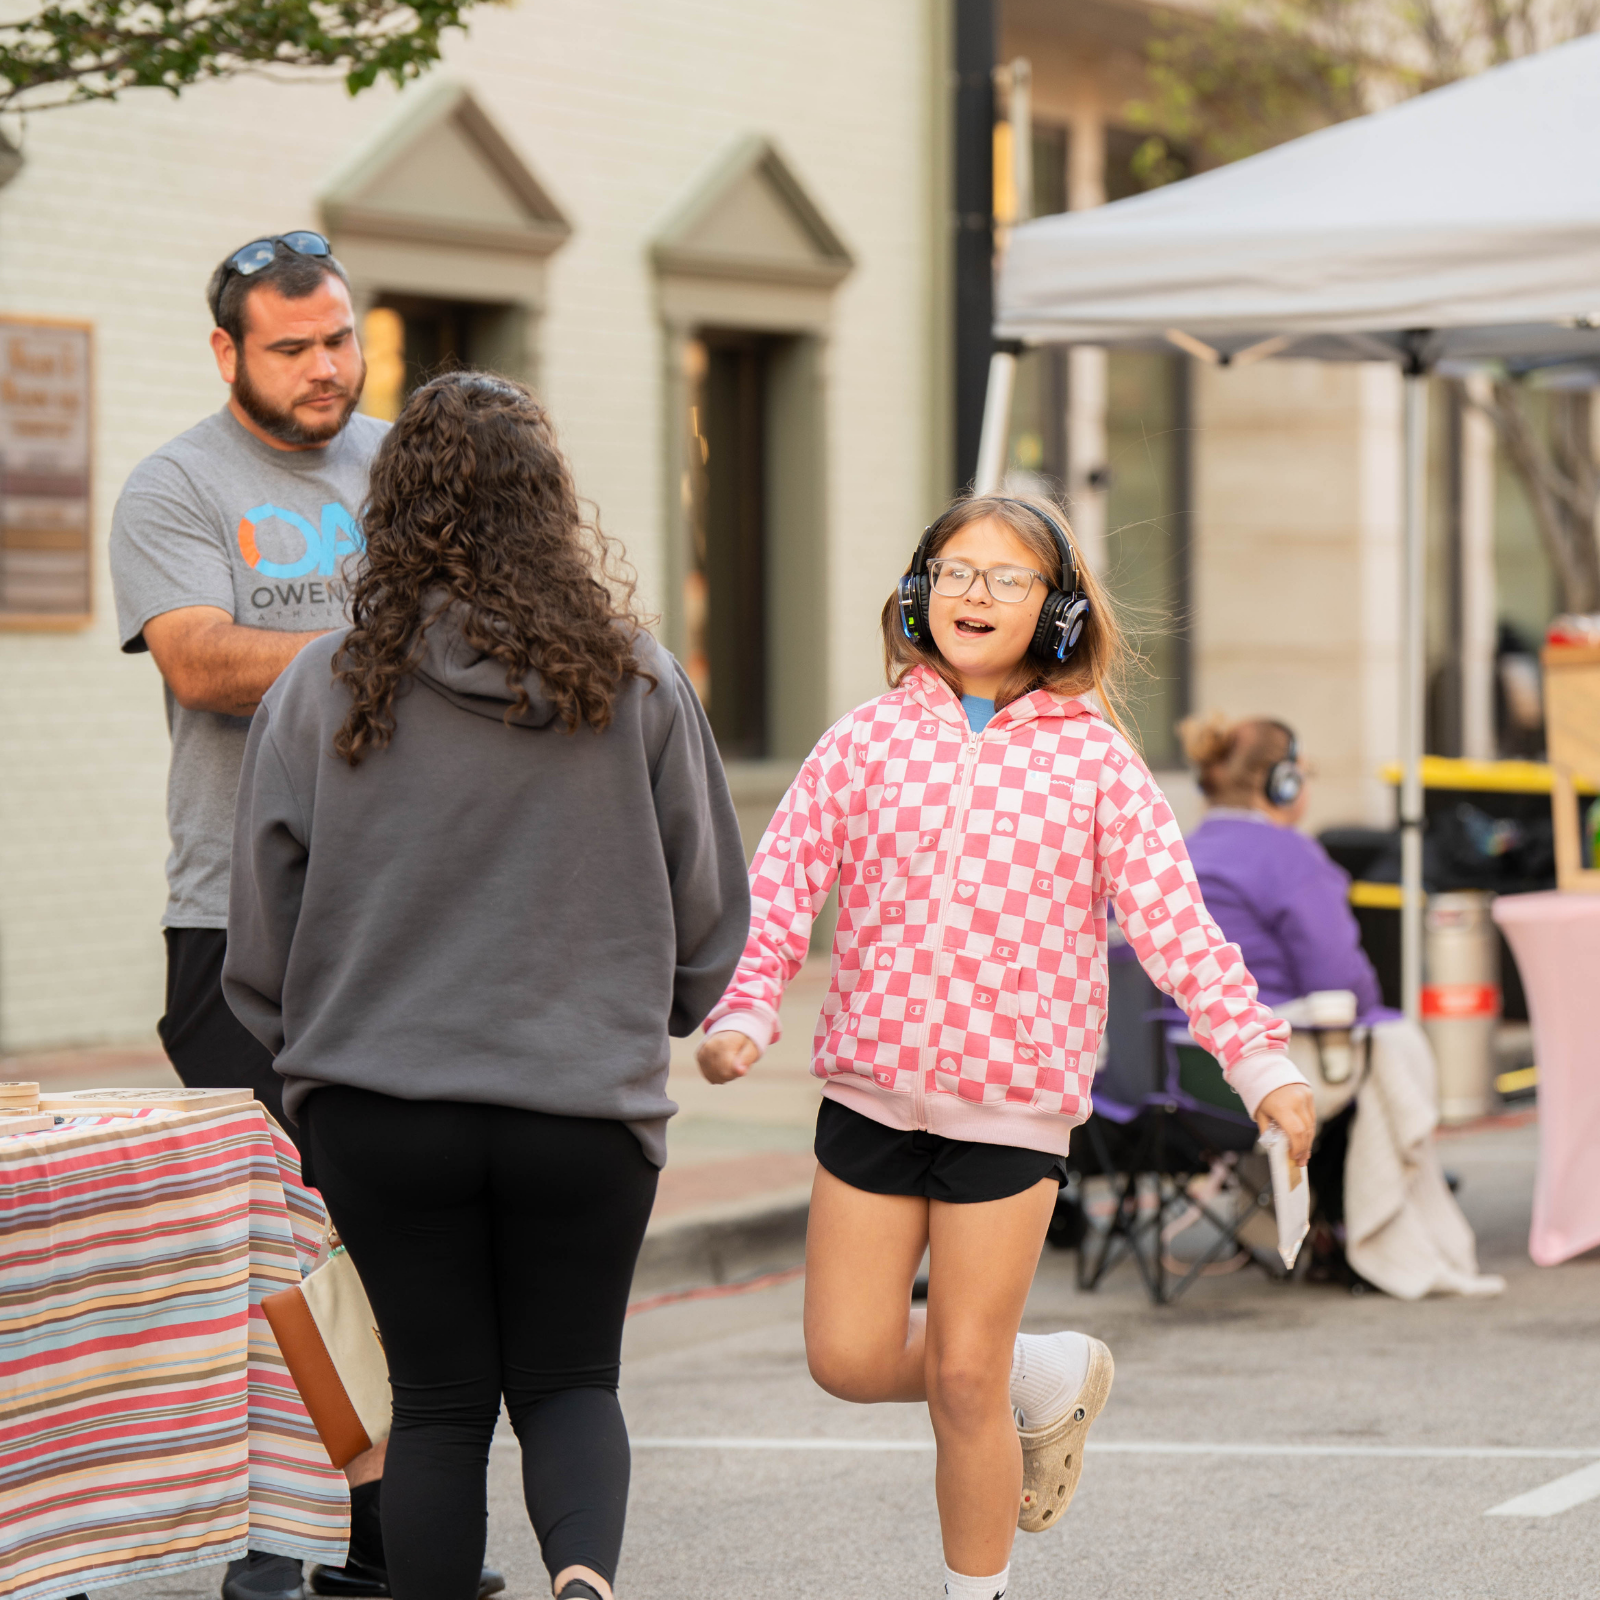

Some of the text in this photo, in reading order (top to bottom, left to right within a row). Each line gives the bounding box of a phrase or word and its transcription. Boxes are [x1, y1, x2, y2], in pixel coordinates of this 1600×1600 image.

[238, 503, 367, 579] OA
[251, 582, 348, 608] OWEN
[258, 608, 335, 621] ATHLE
